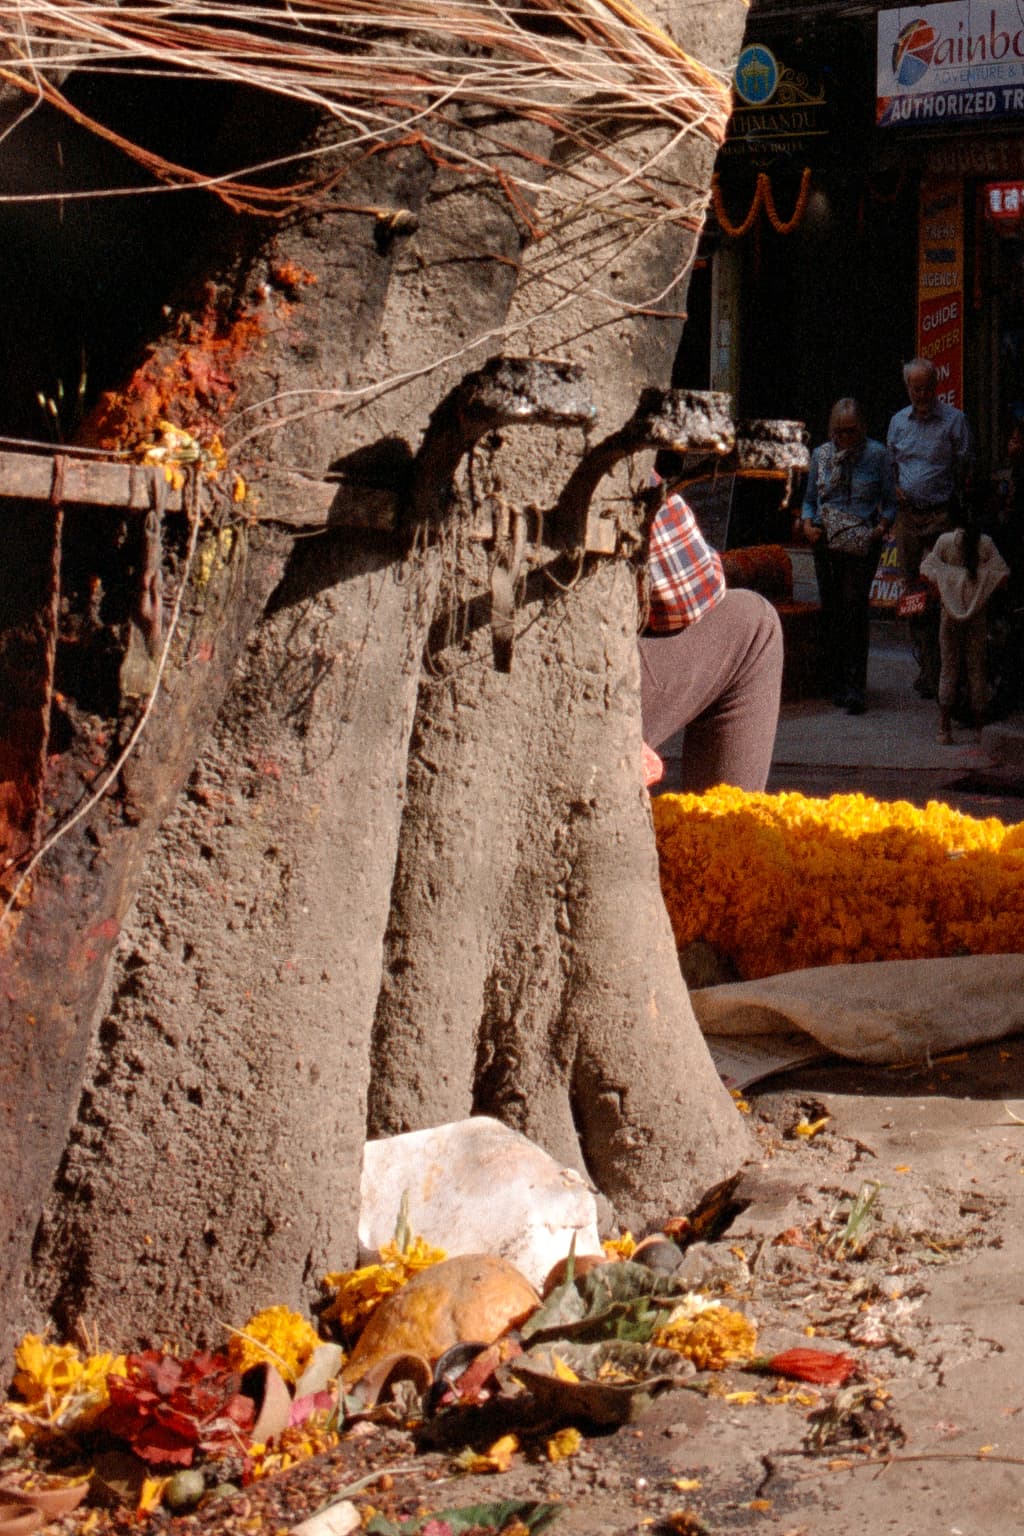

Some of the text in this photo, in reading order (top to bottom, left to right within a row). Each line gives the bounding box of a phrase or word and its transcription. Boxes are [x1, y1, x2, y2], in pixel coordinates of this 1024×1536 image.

[934, 66, 1002, 83] ADVENTURE
[1008, 66, 1017, 77] &
[891, 90, 996, 121] AUTHORIZED
[732, 111, 817, 135] THMANDU
[922, 270, 959, 289] AGENCY
[922, 302, 959, 332] GUIDE
[921, 327, 960, 360] PORTER
